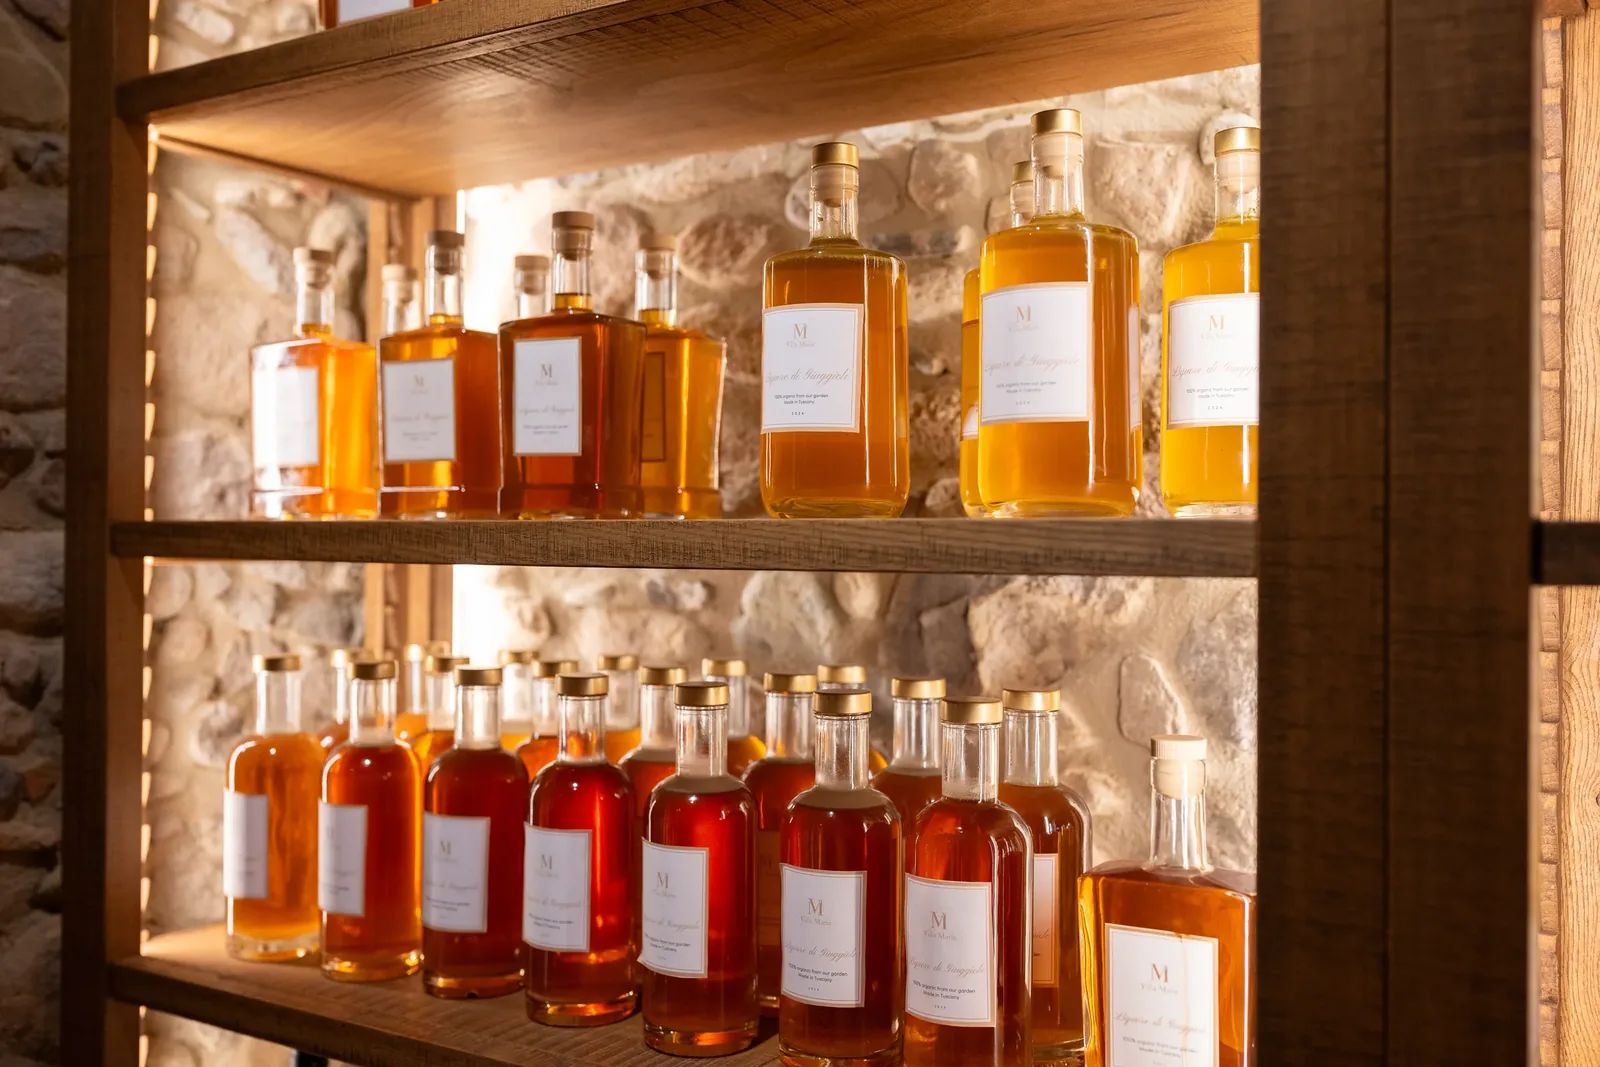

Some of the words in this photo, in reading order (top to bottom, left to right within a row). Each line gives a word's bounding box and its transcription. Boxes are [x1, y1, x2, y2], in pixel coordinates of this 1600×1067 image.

[793, 323, 809, 340] M
[1208, 313, 1226, 332] M
[790, 367, 802, 381] di
[807, 897, 825, 917] M
[930, 910, 948, 931] M
[1150, 962, 1169, 984] M
